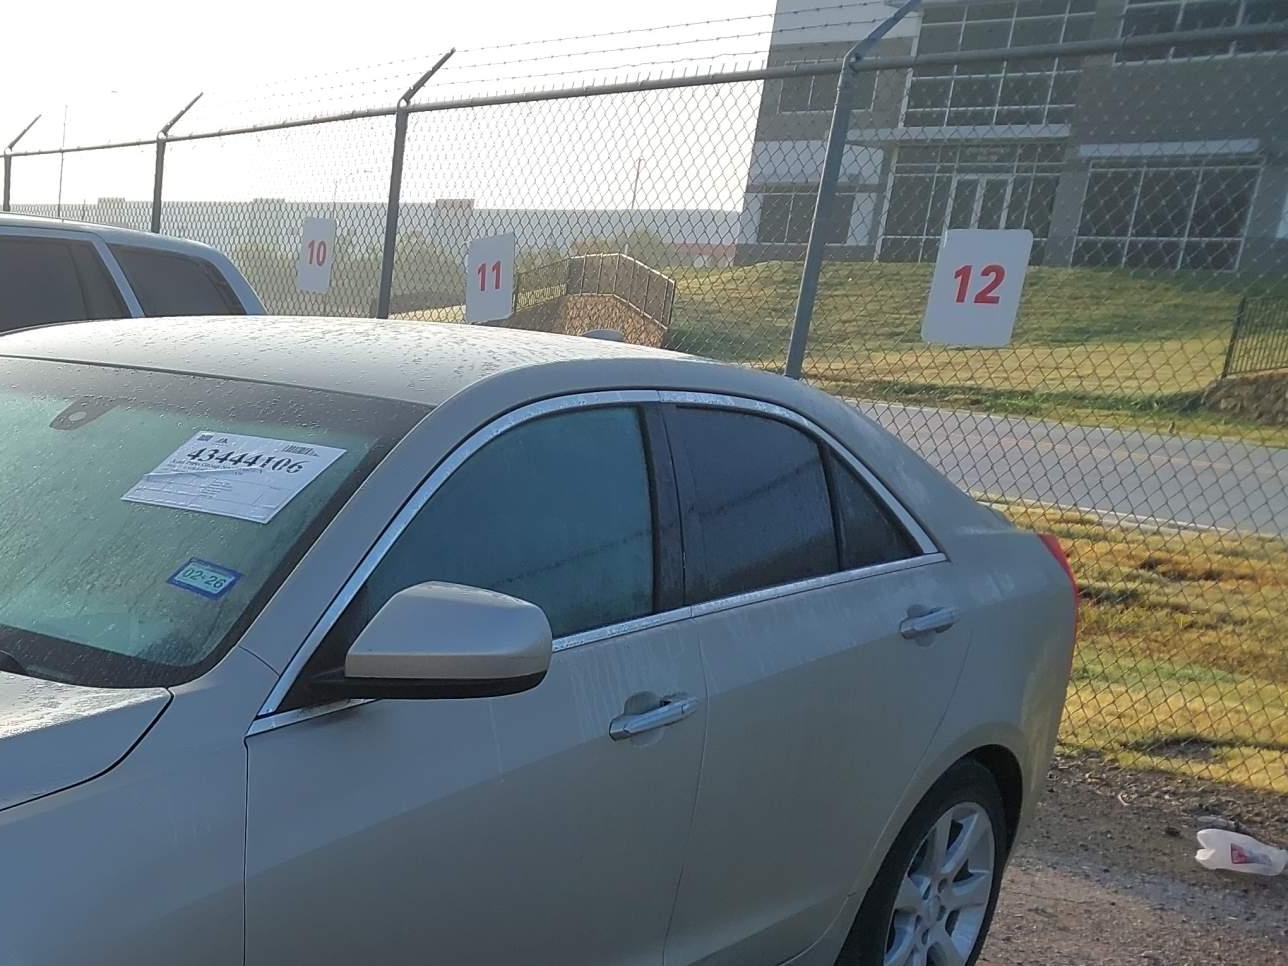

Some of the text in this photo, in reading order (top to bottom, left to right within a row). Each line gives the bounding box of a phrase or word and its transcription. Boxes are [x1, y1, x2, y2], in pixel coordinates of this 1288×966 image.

[307, 239, 327, 267] 10
[478, 260, 503, 292] 11
[953, 264, 1006, 305] 12
[187, 447, 310, 474] 43444106
